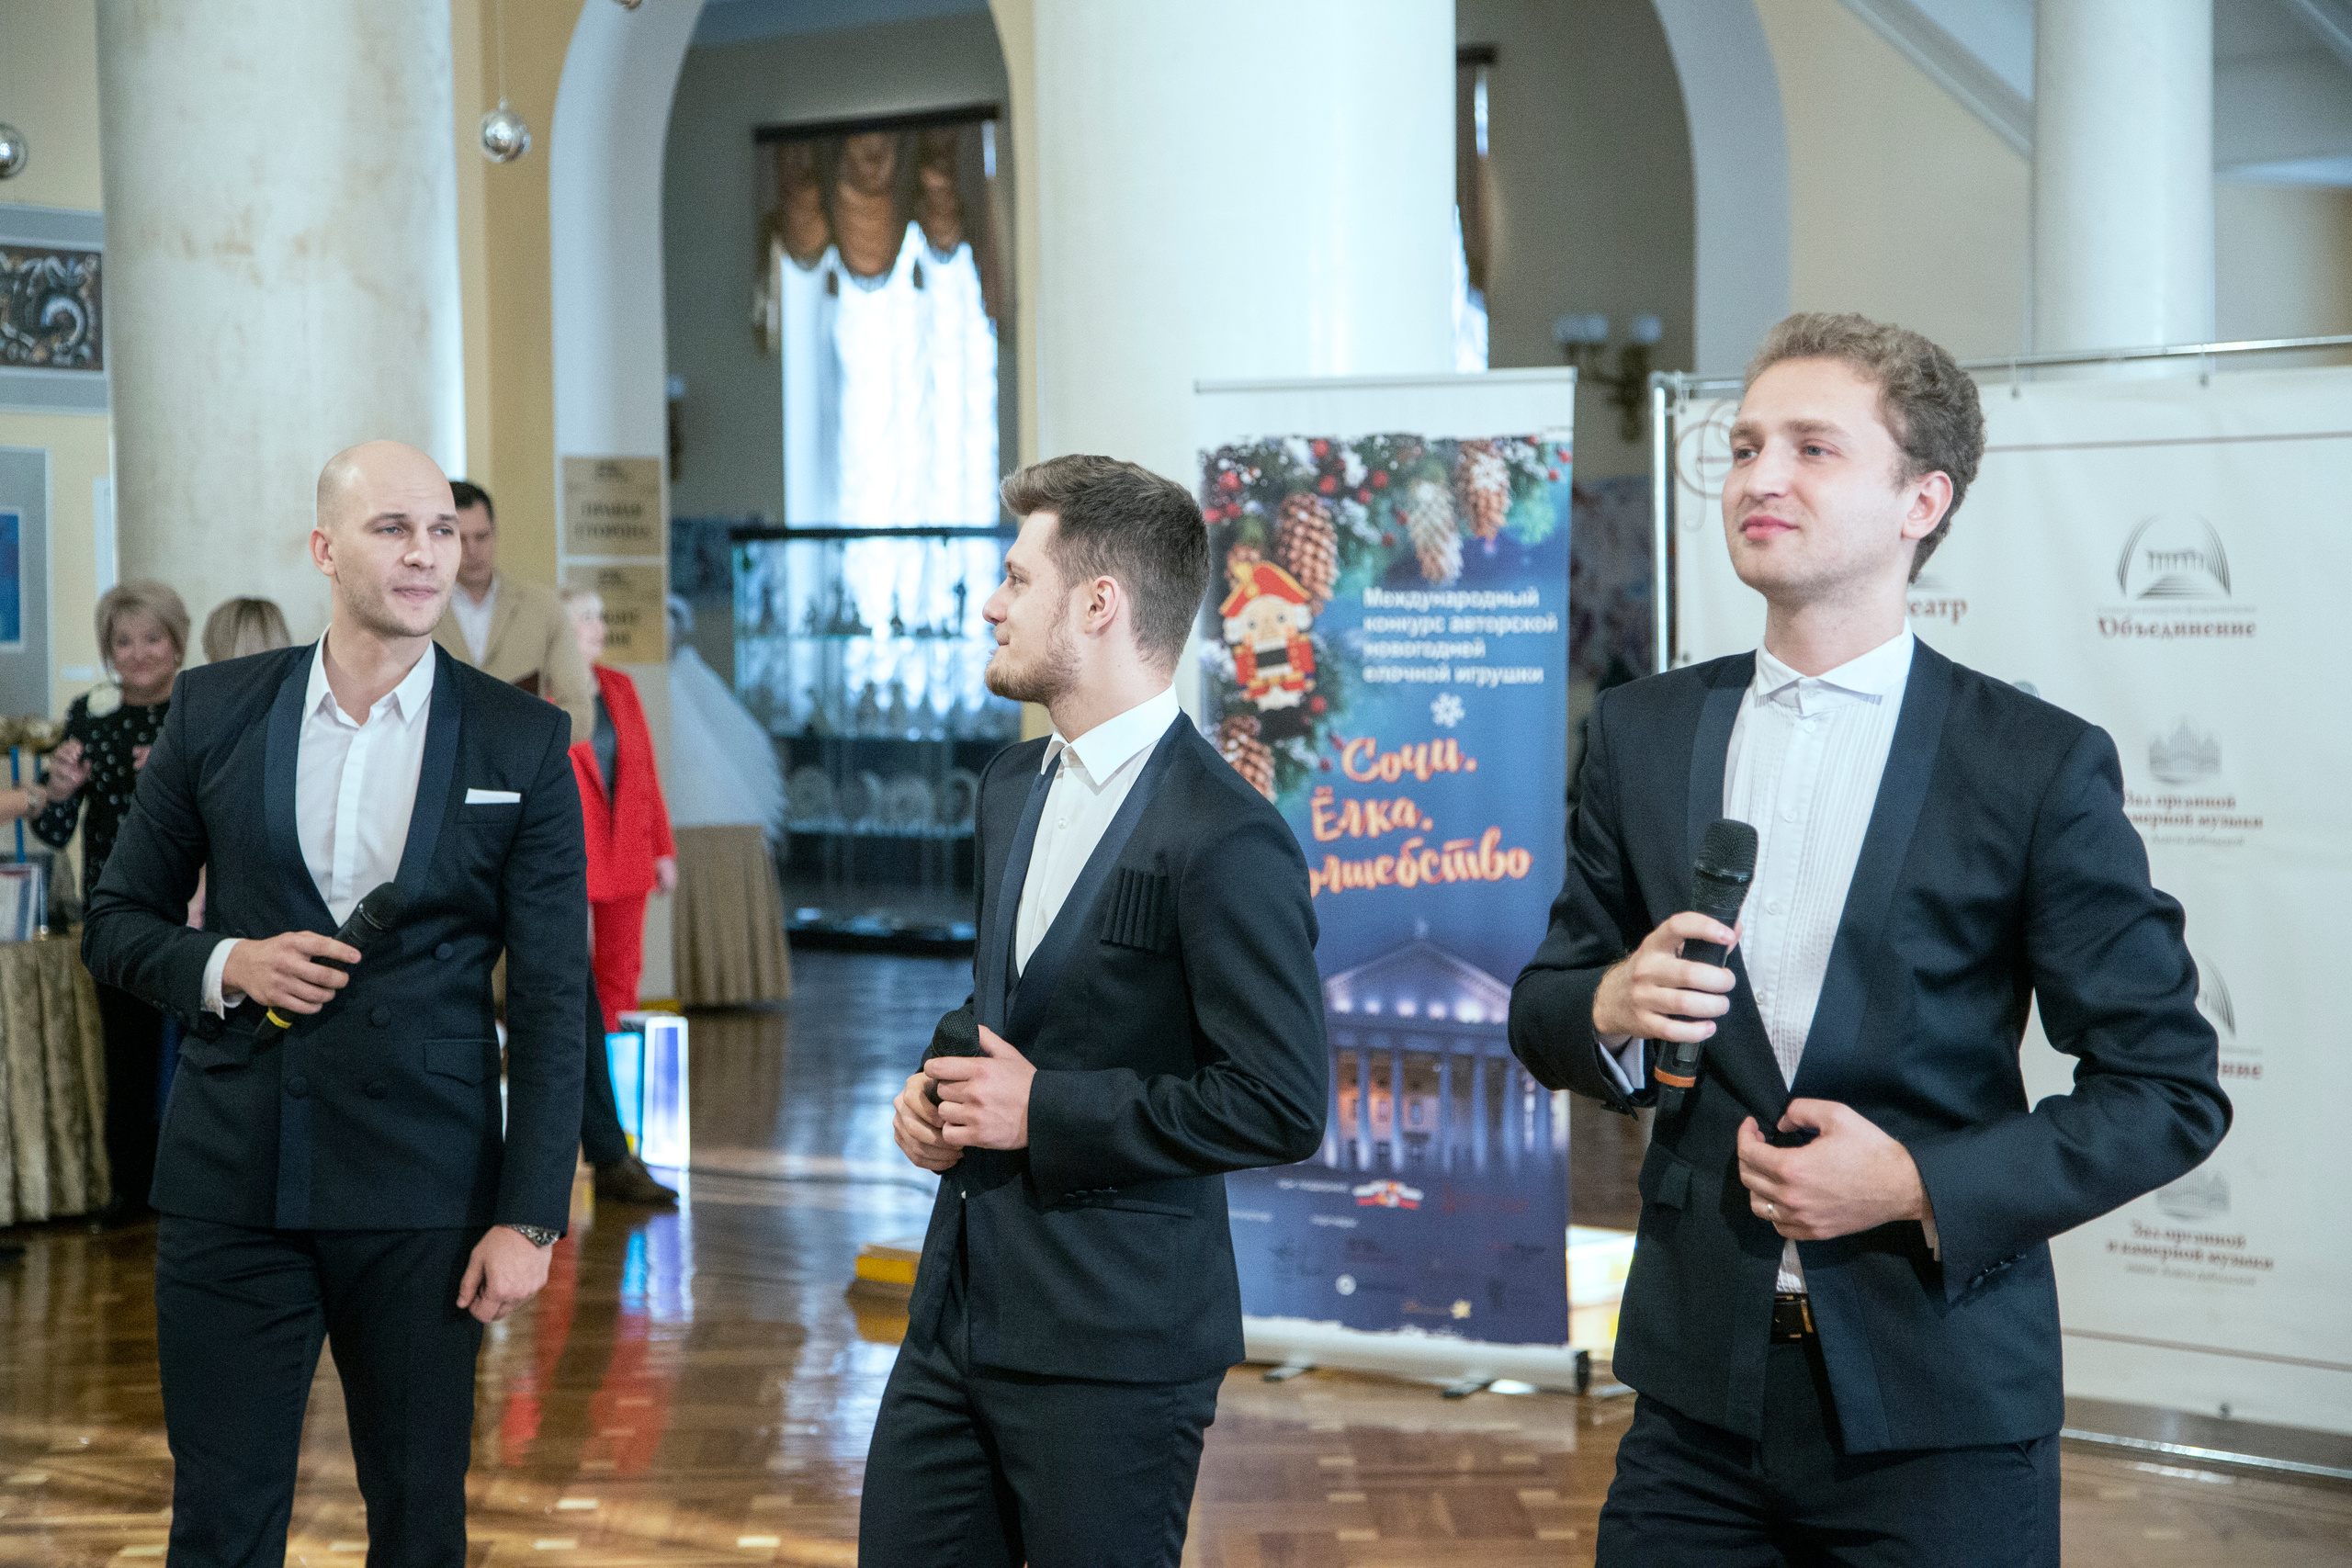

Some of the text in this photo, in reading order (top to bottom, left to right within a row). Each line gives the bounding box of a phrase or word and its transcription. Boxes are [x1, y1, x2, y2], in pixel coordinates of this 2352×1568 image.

[1363, 586, 1540, 613] Международный
[1907, 598, 1968, 625] еатр
[1363, 611, 1558, 637] конкурс авторской
[2098, 615, 2256, 639] Объединение
[1363, 636, 1486, 660] новогодней
[1362, 661, 1544, 688] елочной игрушки
[1341, 737, 1477, 783] Сочи.
[1310, 786, 1433, 841] Ёлка.
[1308, 826, 1534, 898] олшебство
